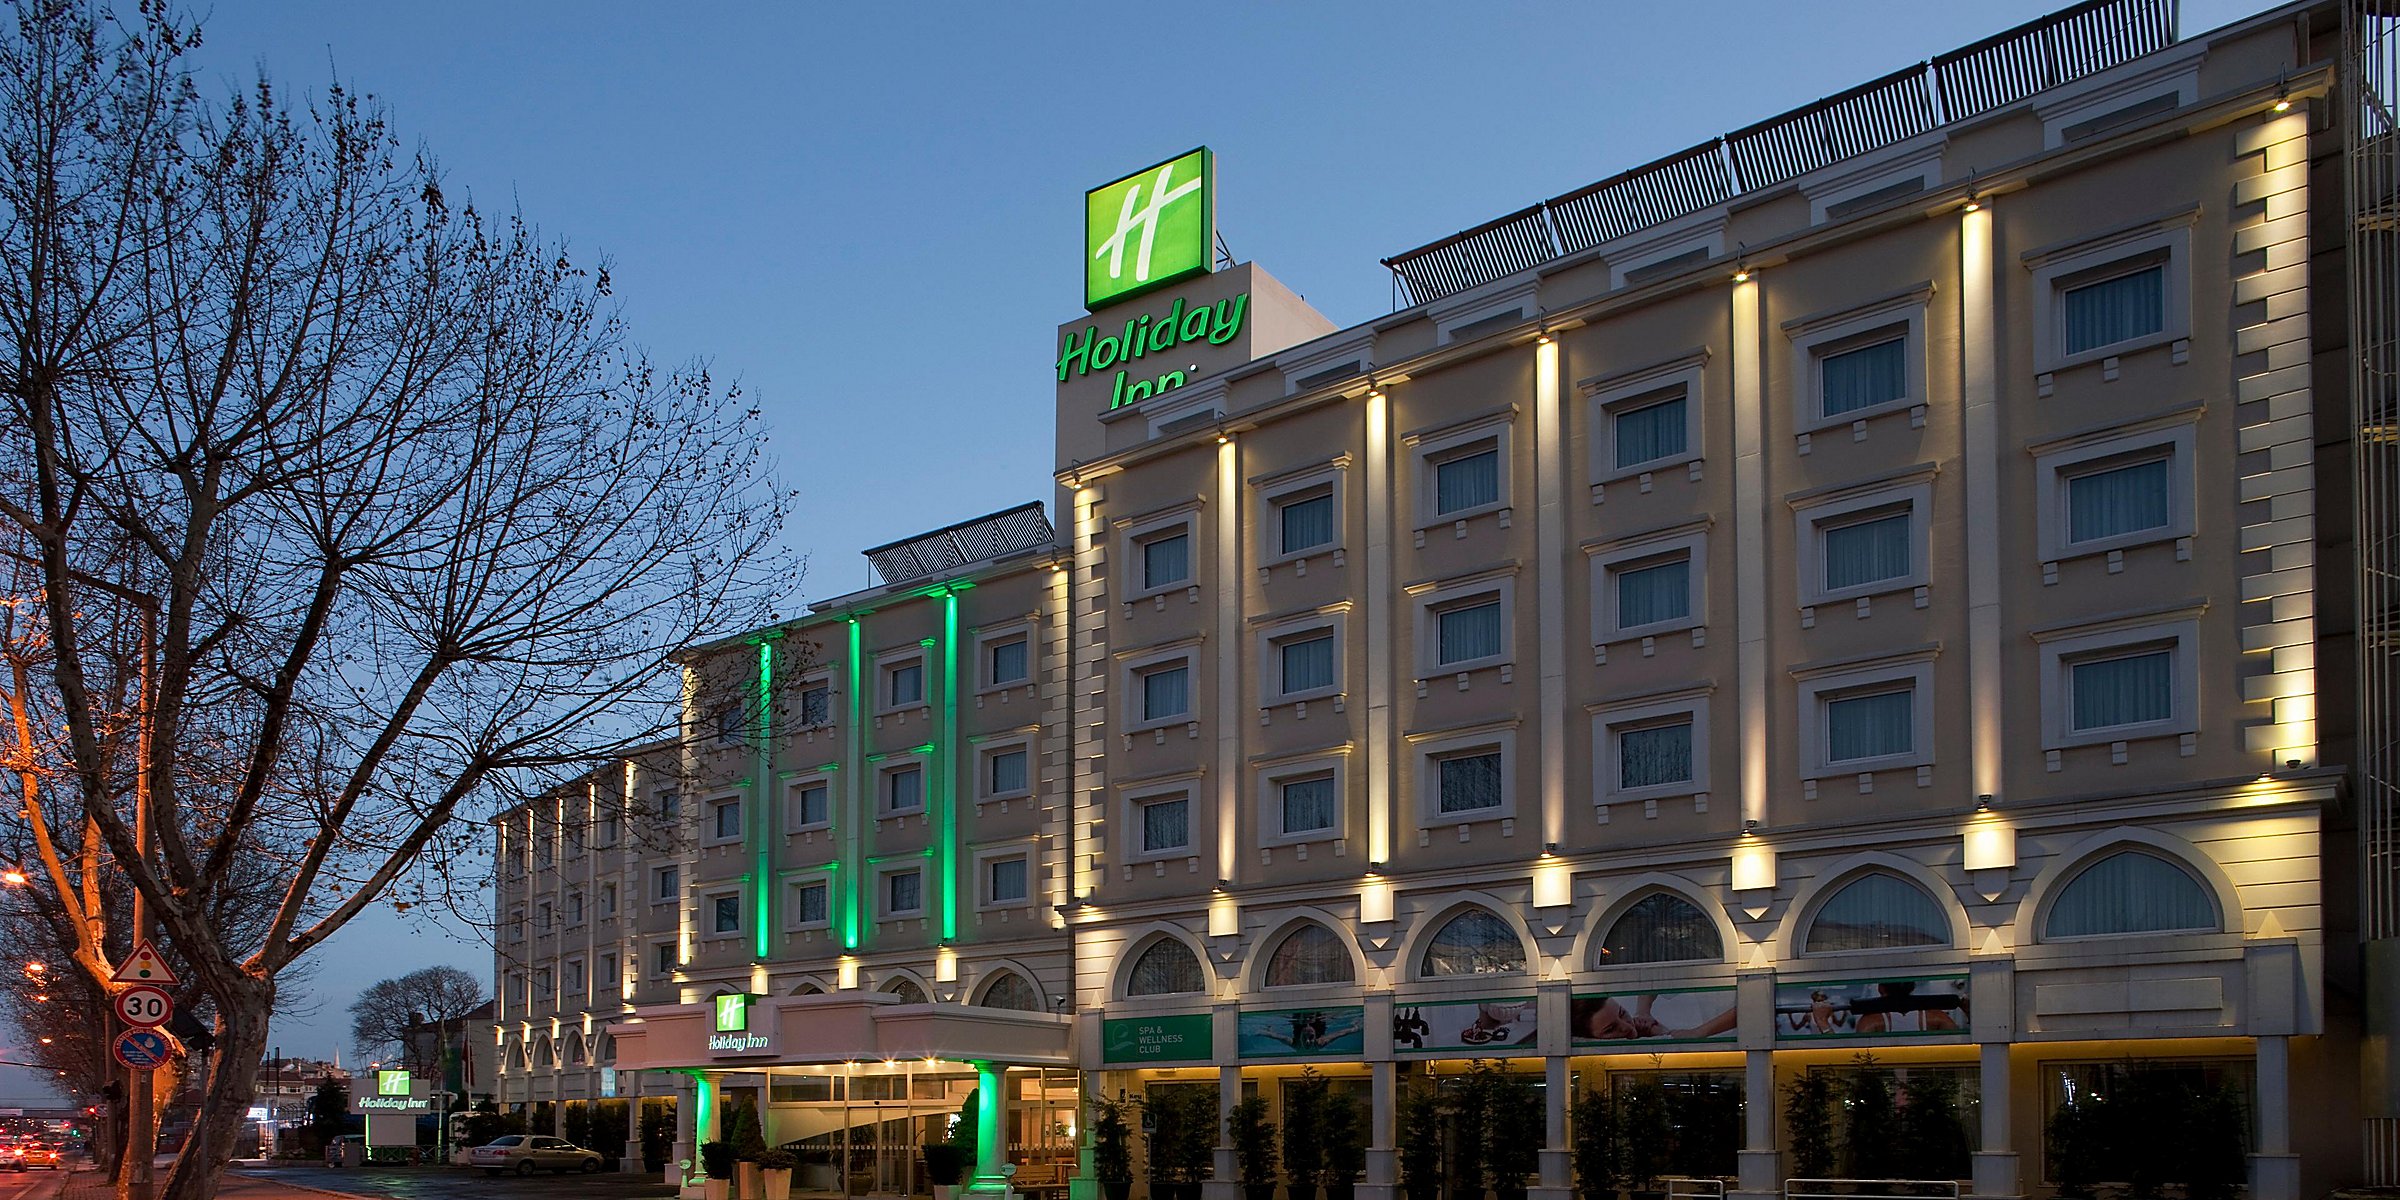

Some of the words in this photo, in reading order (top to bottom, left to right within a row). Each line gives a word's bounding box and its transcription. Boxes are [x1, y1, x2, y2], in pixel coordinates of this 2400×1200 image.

[1055, 292, 1249, 382] Holiday
[126, 996, 163, 1017] 30
[1139, 1026, 1155, 1035] SPA
[1157, 1025, 1163, 1034] &
[708, 1034, 746, 1052] Holiday
[747, 1032, 768, 1048] Inn
[1139, 1034, 1183, 1044] WELLNESS
[1139, 1045, 1161, 1054] CLUB
[358, 1096, 408, 1110] Holiday
[408, 1096, 427, 1108] Inn
